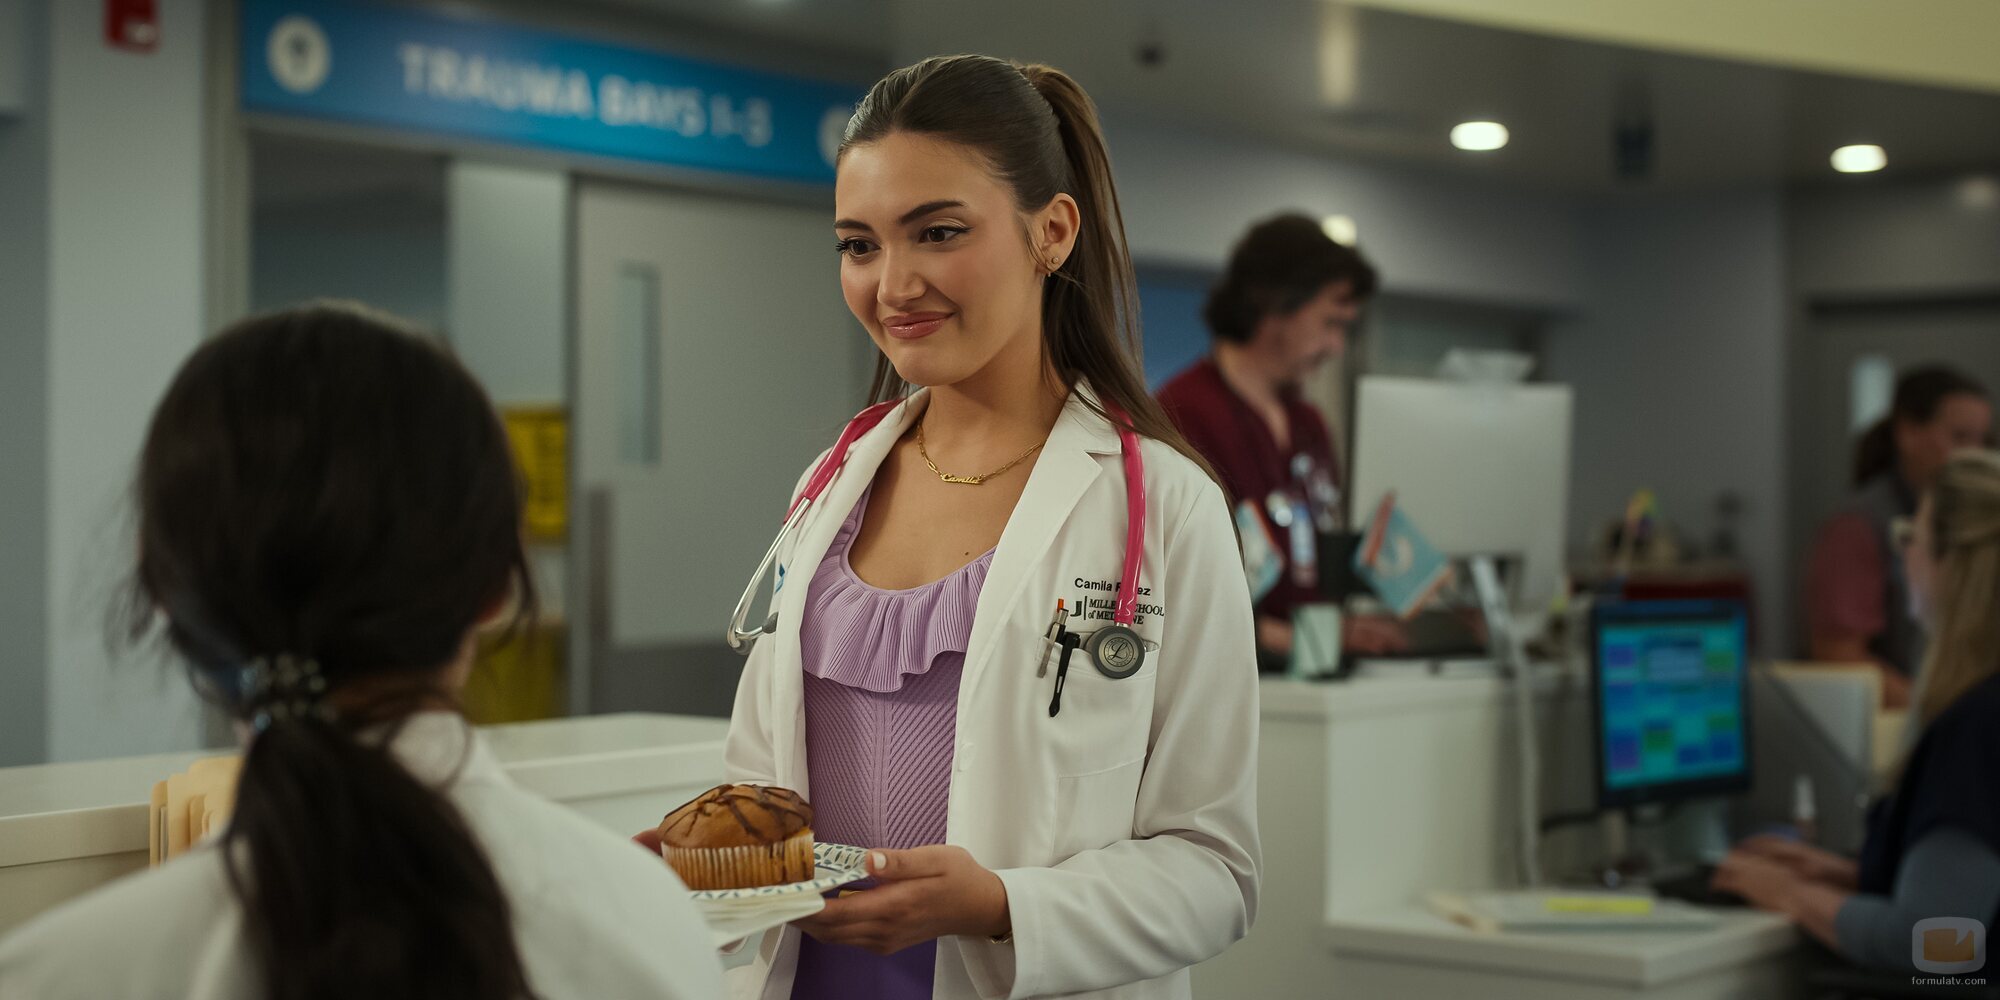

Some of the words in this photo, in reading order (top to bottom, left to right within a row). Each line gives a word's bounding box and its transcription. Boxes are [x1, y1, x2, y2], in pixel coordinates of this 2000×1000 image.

[402, 44, 594, 118] TRAUMA
[600, 74, 705, 137] BAYS
[1074, 577, 1112, 592] Camila
[1115, 582, 1151, 596] Pez
[1088, 598, 1116, 610] MILLE
[1088, 609, 1097, 620] of
